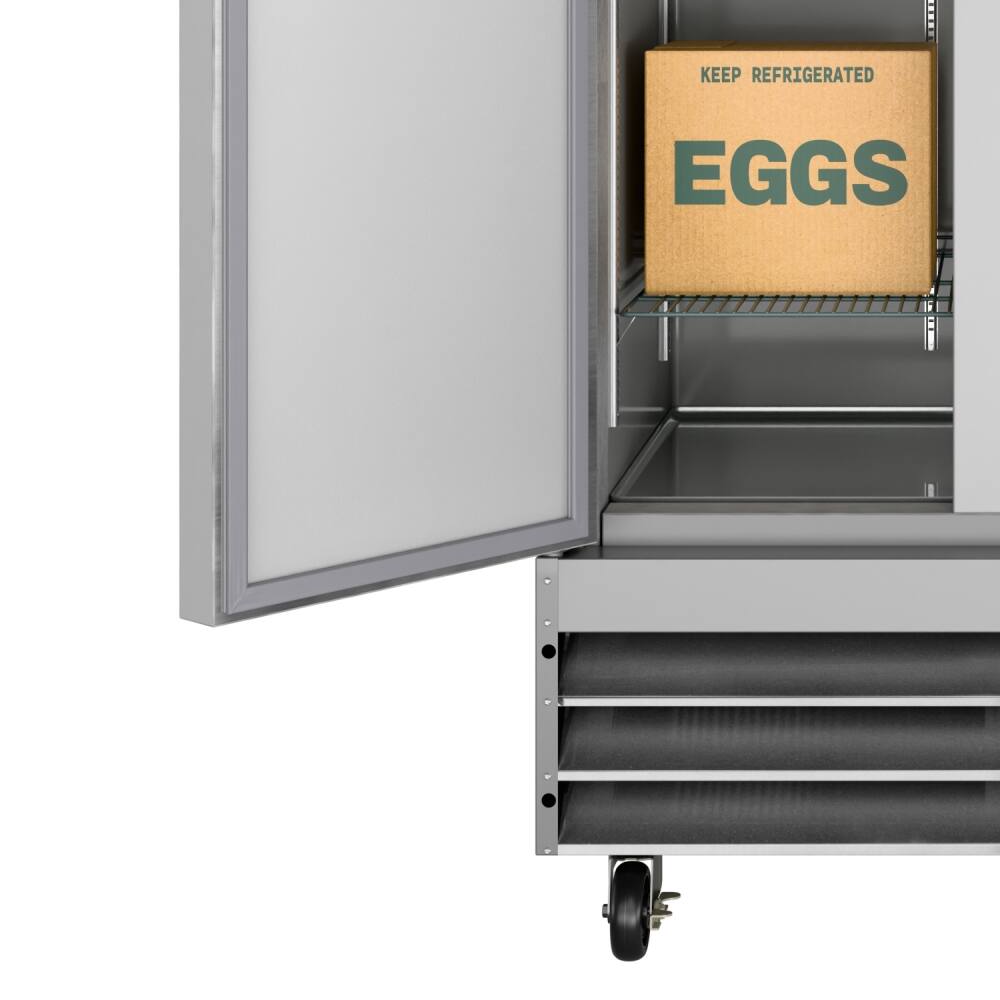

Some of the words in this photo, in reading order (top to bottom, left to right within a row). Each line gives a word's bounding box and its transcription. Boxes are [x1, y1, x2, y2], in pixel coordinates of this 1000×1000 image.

[700, 66, 741, 83] KEEP
[751, 66, 874, 83] REFRIGERATED
[674, 139, 909, 206] EGGS
